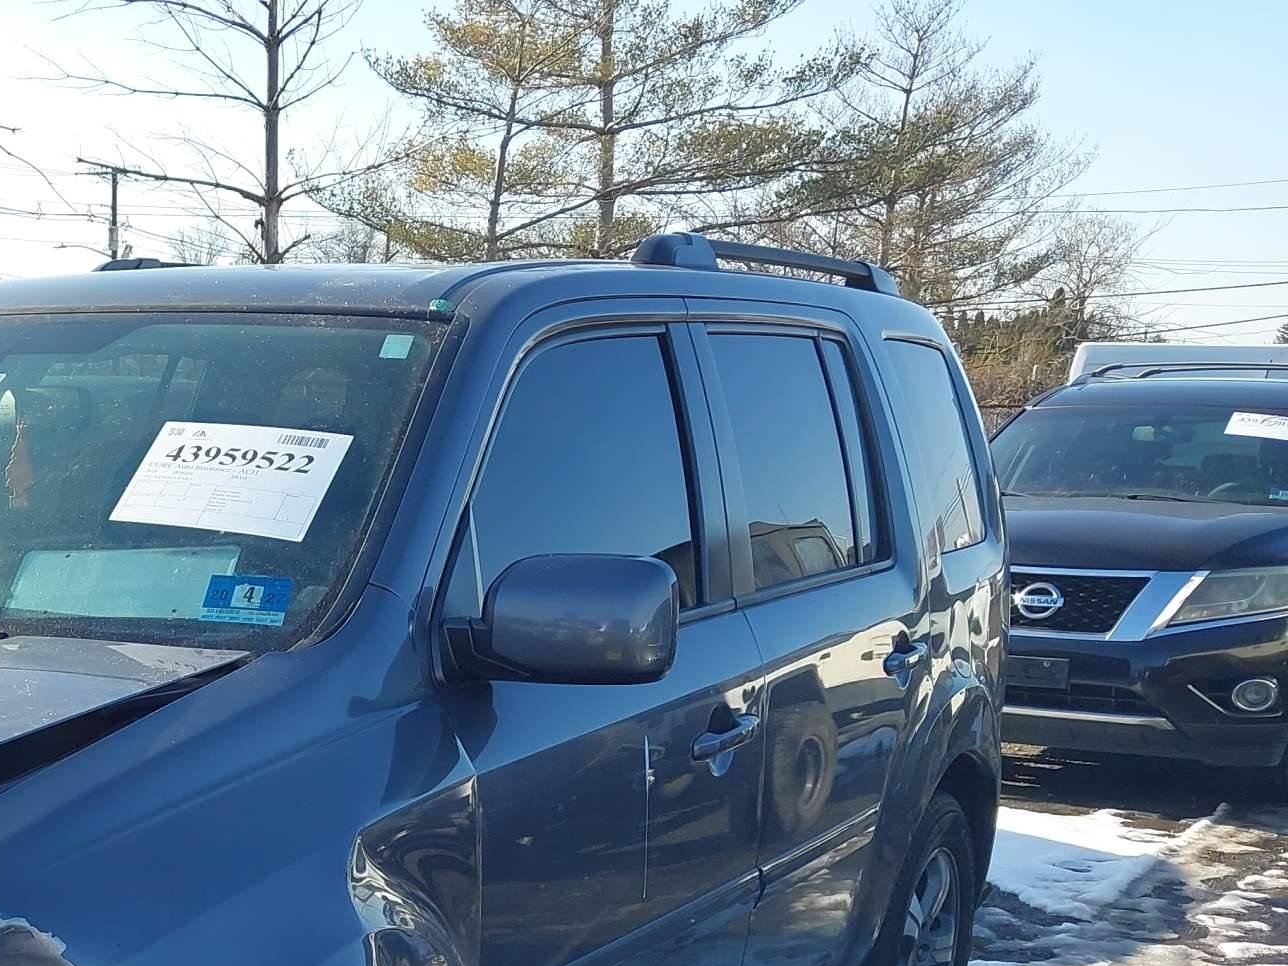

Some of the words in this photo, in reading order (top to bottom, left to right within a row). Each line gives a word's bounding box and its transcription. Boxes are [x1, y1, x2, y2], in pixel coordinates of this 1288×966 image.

[165, 444, 316, 475] 43959522
[210, 589, 229, 601] 20
[242, 586, 256, 604] 4
[1019, 597, 1058, 605] NISSAN
